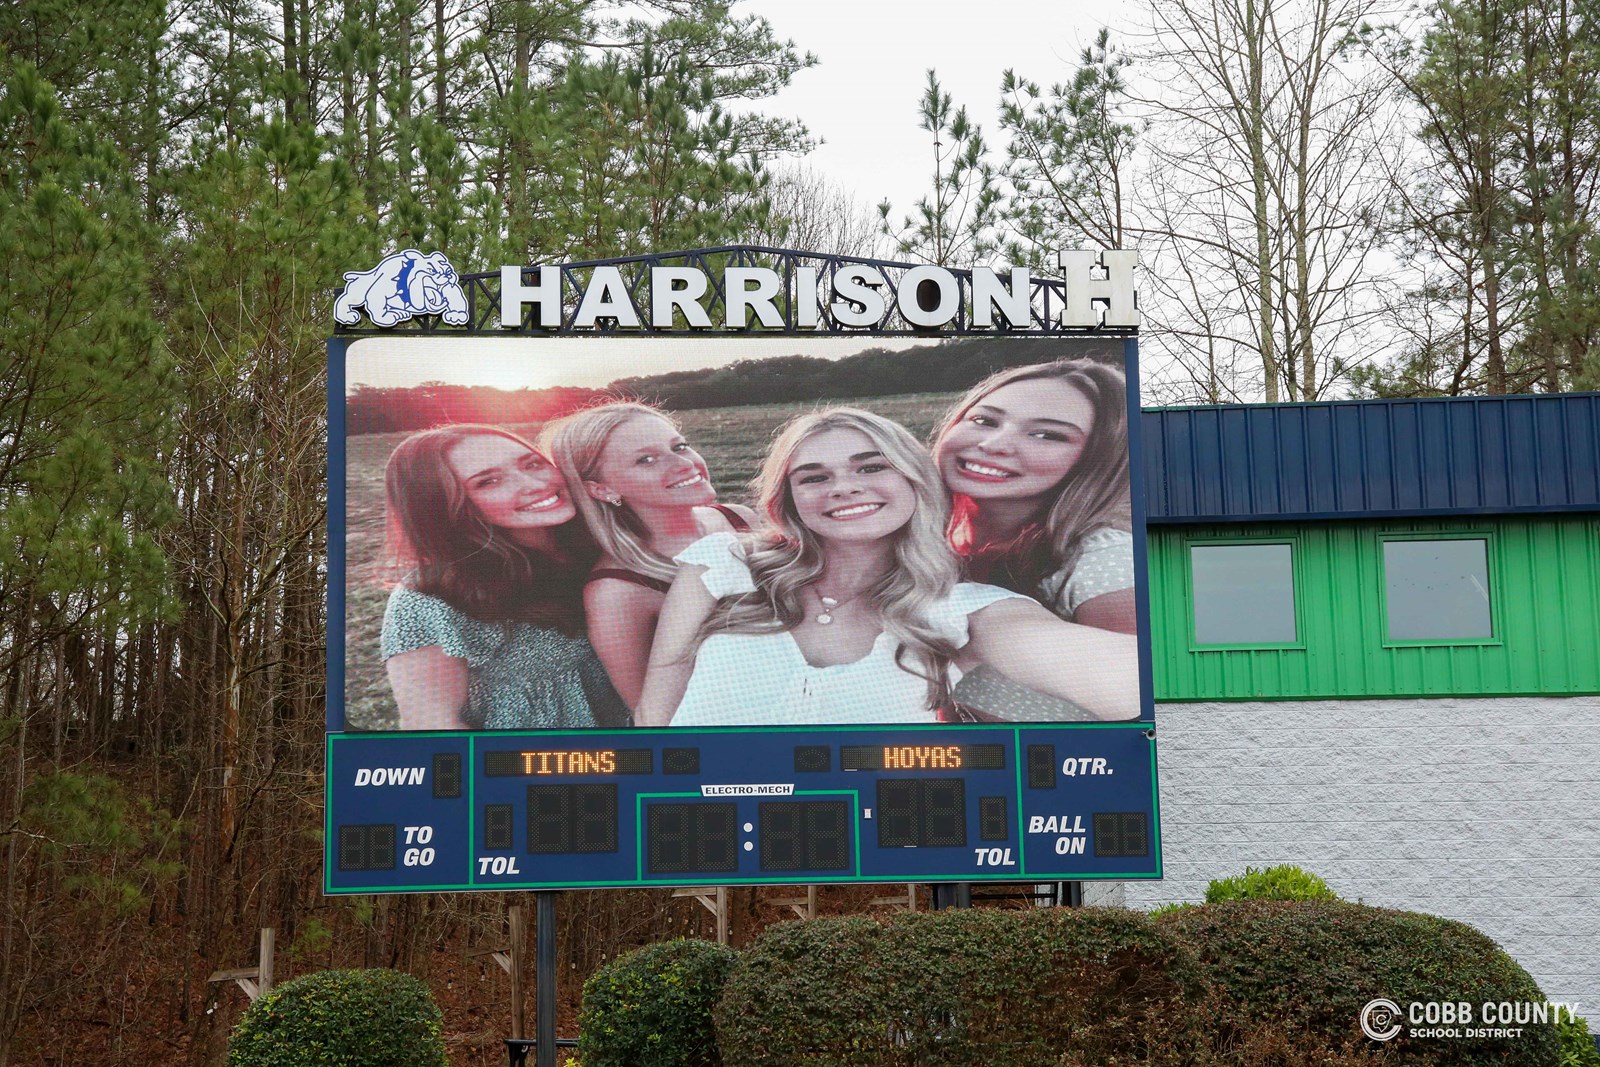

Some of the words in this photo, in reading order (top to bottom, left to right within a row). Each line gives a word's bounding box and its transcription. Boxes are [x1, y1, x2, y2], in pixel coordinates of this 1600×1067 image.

[499, 265, 1033, 329] HARRISON
[1058, 249, 1139, 329] H
[521, 751, 616, 775] TITANS
[884, 746, 961, 768] HOYAS
[1062, 757, 1114, 777] QTR.
[354, 767, 425, 787] DOWN
[705, 786, 790, 795] ELECTRO-MECH
[1028, 815, 1087, 834] BALL
[403, 826, 433, 845] TO
[1055, 836, 1087, 855] ON
[403, 848, 436, 867] GO
[477, 857, 521, 876] TOL
[974, 848, 1016, 867] TOL
